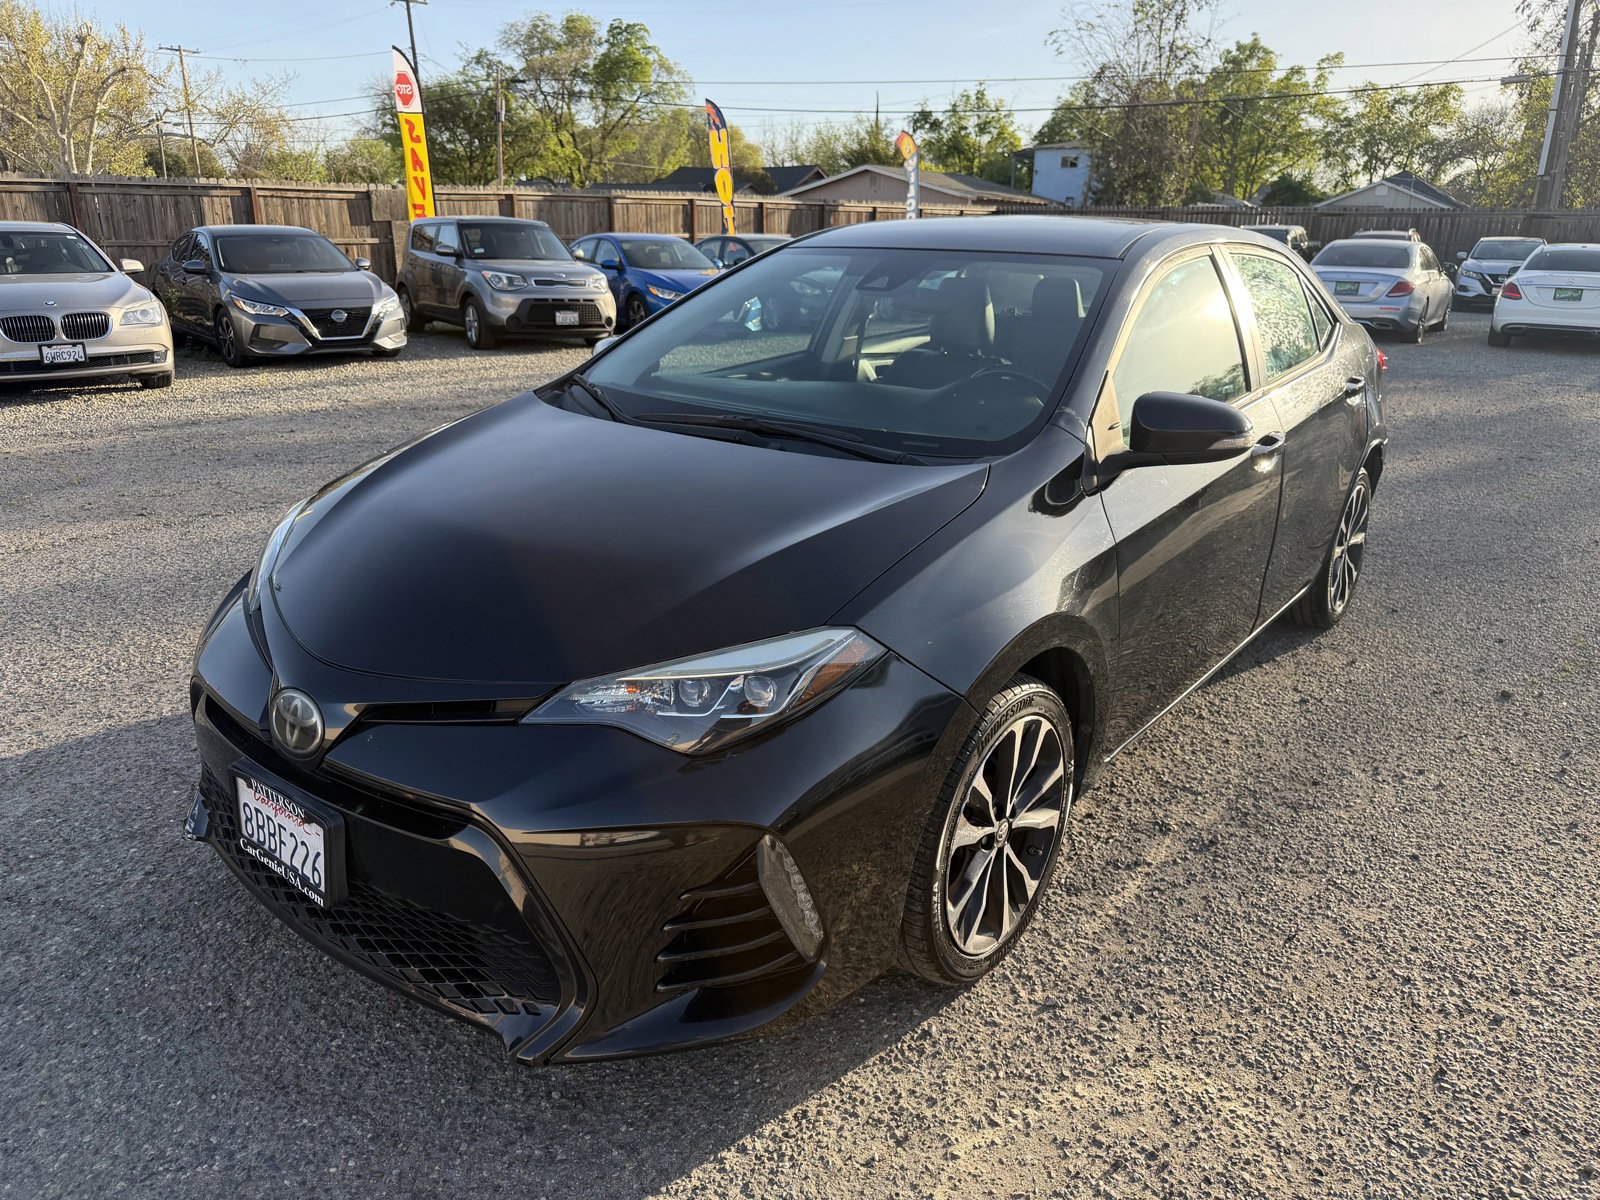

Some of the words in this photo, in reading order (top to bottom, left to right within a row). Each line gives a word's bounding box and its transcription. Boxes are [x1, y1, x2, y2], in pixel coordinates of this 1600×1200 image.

[709, 130, 735, 236] HOT
[45, 350, 83, 362] 6WRC924
[976, 694, 1036, 757] BRIDGESTONE
[250, 778, 305, 819] PATTERSON
[239, 837, 324, 907] CarGenieUSA.com
[242, 801, 322, 889] 8BBF226
